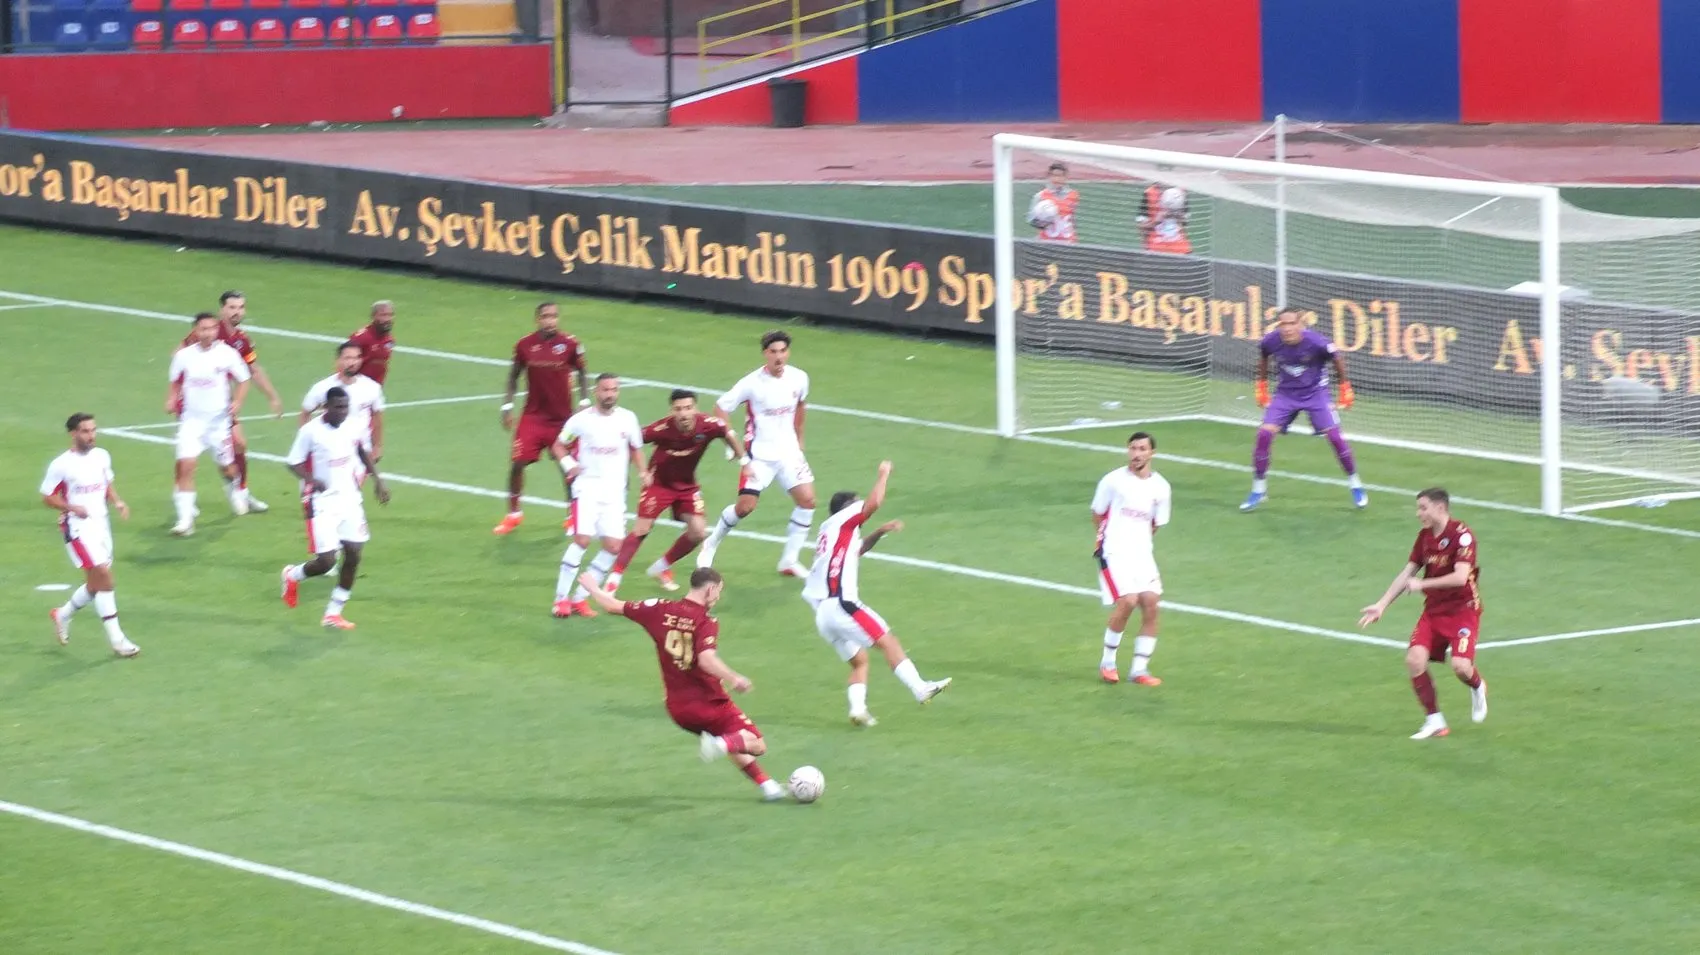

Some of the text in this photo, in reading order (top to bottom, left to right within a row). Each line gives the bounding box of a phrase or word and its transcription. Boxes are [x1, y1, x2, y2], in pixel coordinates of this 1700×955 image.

[69, 160, 229, 221] Başarılar
[233, 176, 327, 229] Diler
[348, 189, 410, 241] Av.
[416, 197, 547, 258] Şevket
[551, 213, 656, 274] Çelik
[659, 224, 818, 289] Mardin
[826, 248, 930, 312] 1969
[1328, 298, 1459, 363] Diler
